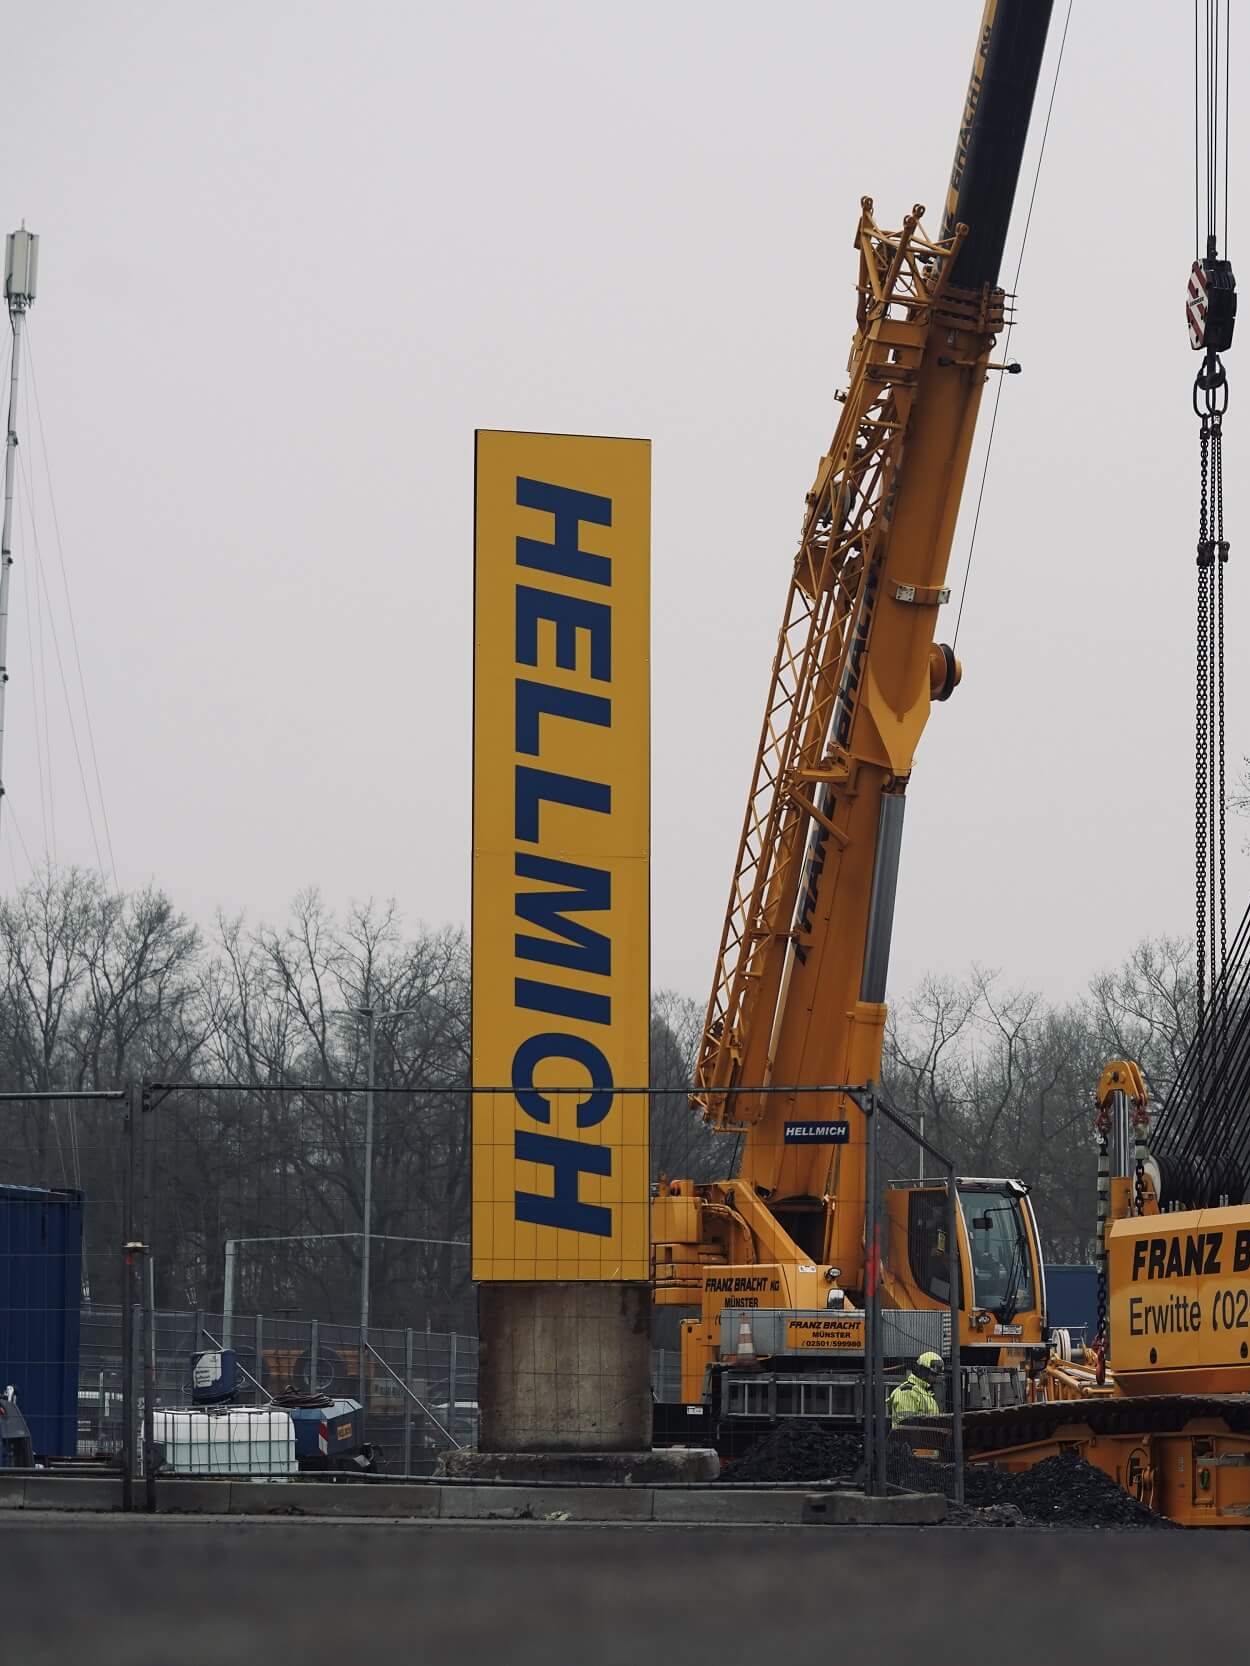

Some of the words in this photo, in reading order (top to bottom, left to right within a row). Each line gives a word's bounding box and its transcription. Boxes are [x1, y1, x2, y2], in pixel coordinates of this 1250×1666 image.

[511, 474, 614, 1238] HELLMICH
[786, 1127, 846, 1136] HELLMICH
[1131, 1231, 1224, 1281] FRANZ
[705, 1278, 733, 1292] FRANZ
[734, 1277, 768, 1291] BRACHT
[770, 1280, 780, 1291] KG
[725, 1294, 759, 1307] MÜNSTER
[1130, 1294, 1201, 1336] Erwitte
[789, 1321, 823, 1329] FRANZ
[823, 1321, 862, 1329] BRACHT
[812, 1330, 850, 1338] MÜNSTER
